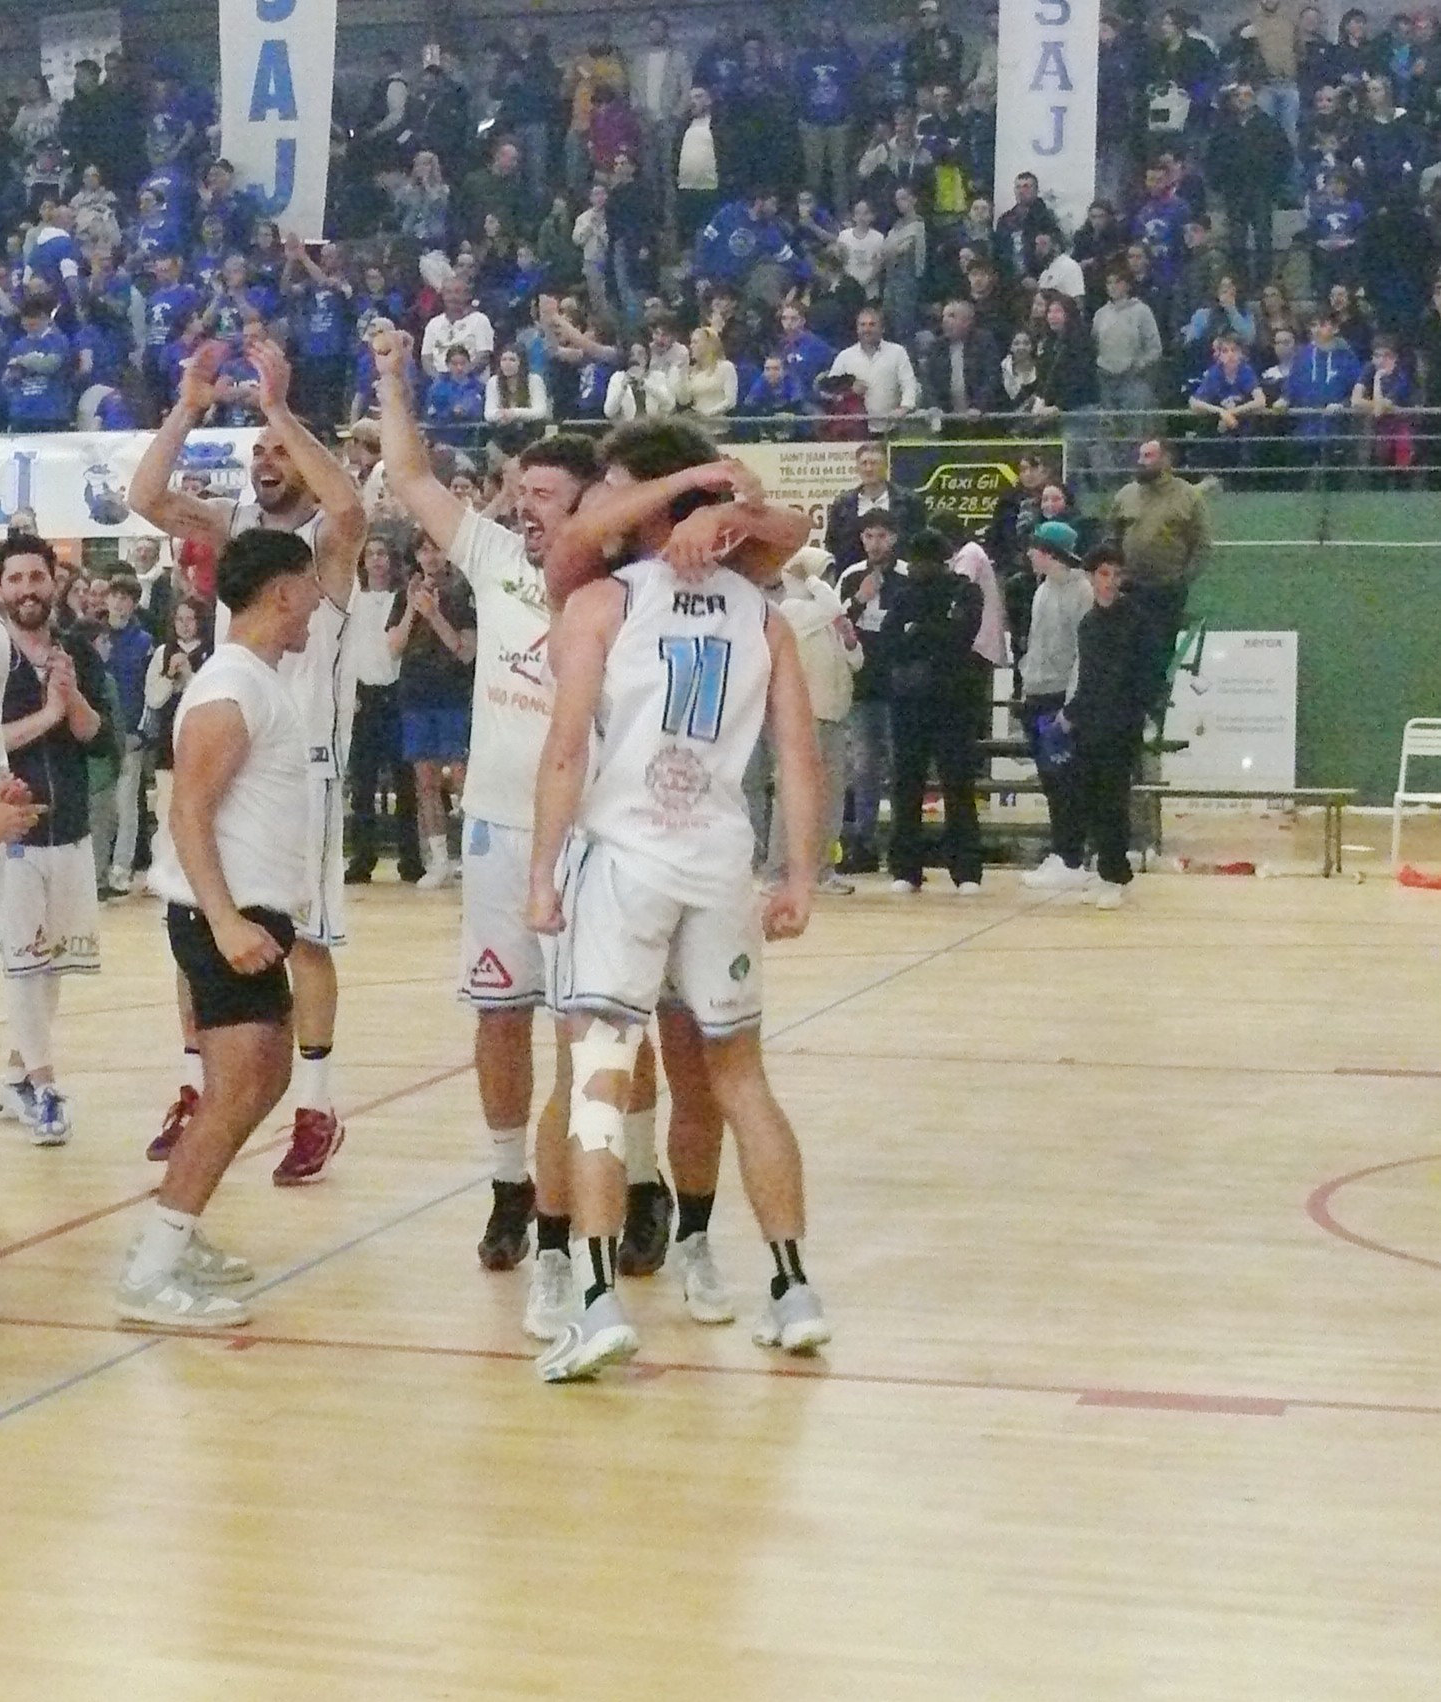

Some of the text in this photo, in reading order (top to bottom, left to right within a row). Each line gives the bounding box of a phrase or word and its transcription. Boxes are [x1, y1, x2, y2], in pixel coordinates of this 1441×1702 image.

[938, 474, 1000, 490] Taxi Gil
[658, 633, 732, 744] 11
